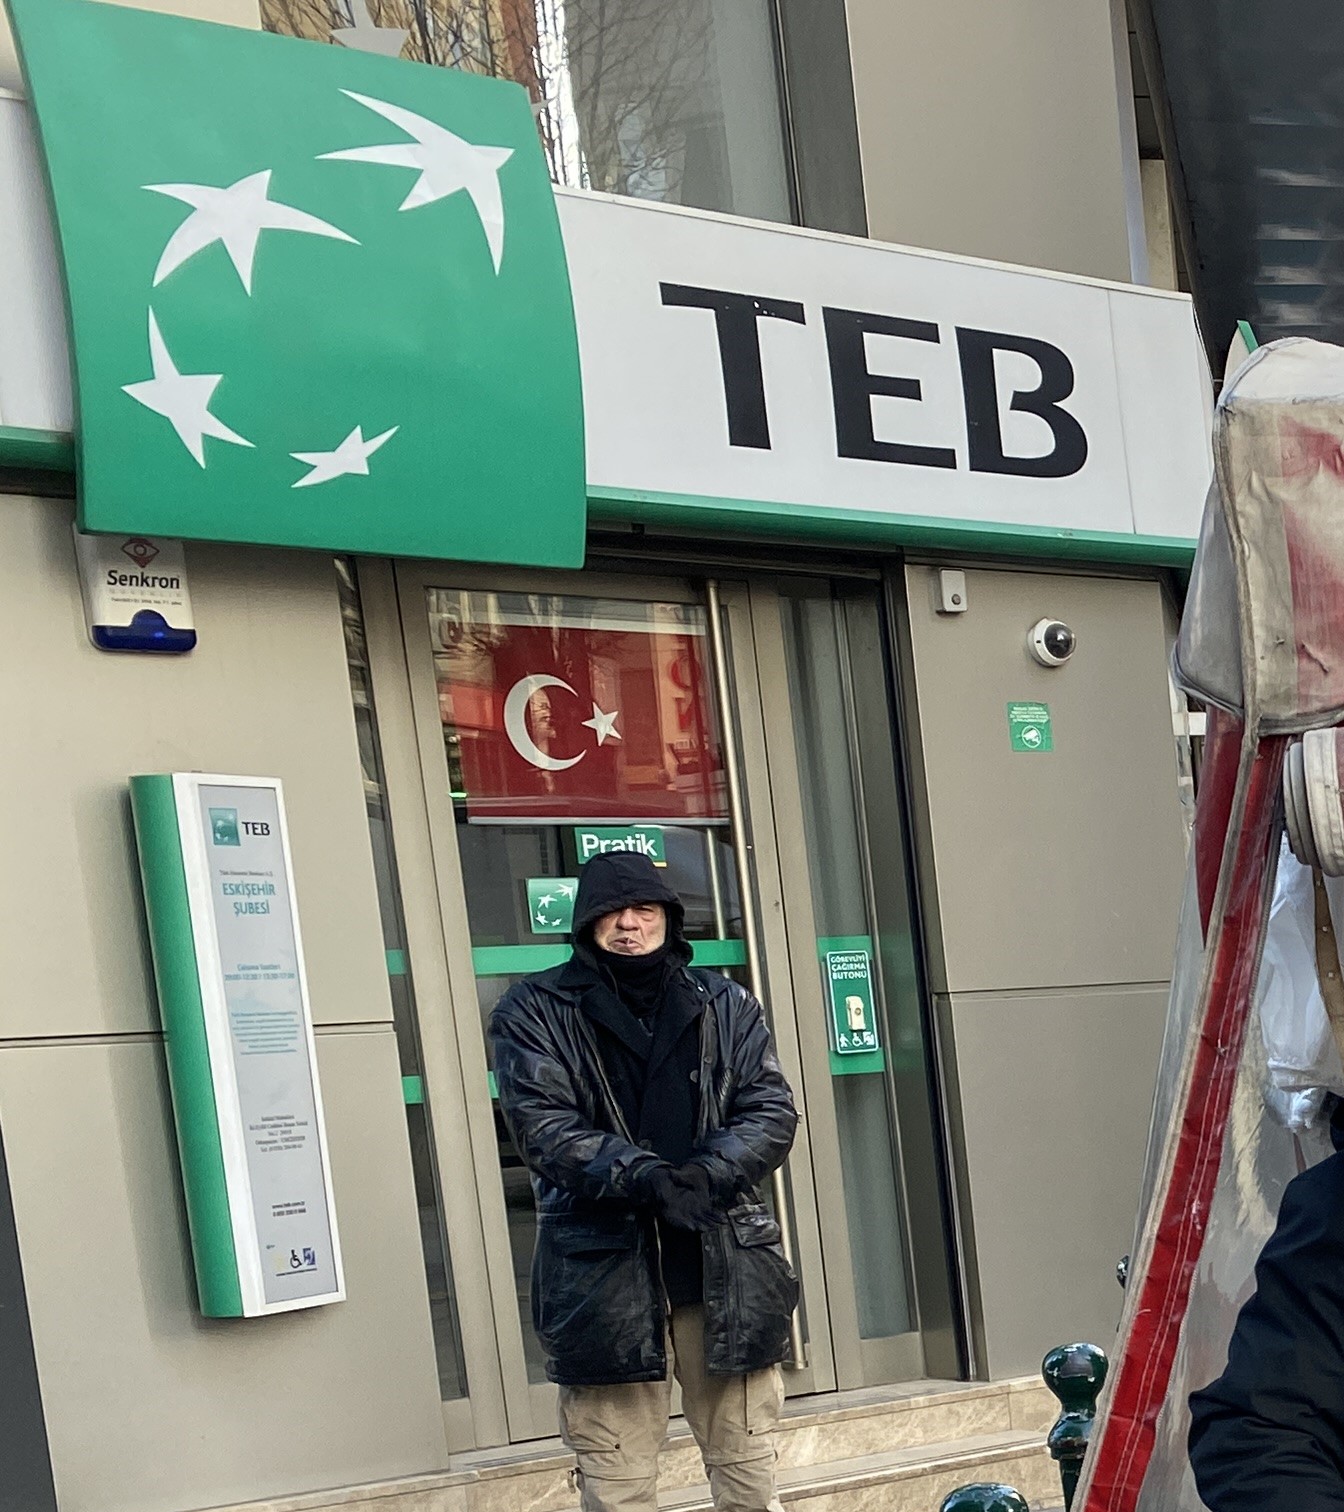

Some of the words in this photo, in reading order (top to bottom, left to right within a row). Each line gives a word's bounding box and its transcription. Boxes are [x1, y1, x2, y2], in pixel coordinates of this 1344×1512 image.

[659, 281, 1088, 478] TEB
[107, 570, 181, 589] Senkron
[241, 821, 270, 836] TEB
[581, 833, 657, 857] Pratik
[222, 881, 276, 897] ESKİŞEHİR
[233, 900, 270, 917] ŞUBESİ
[832, 971, 867, 980] BUTONU
